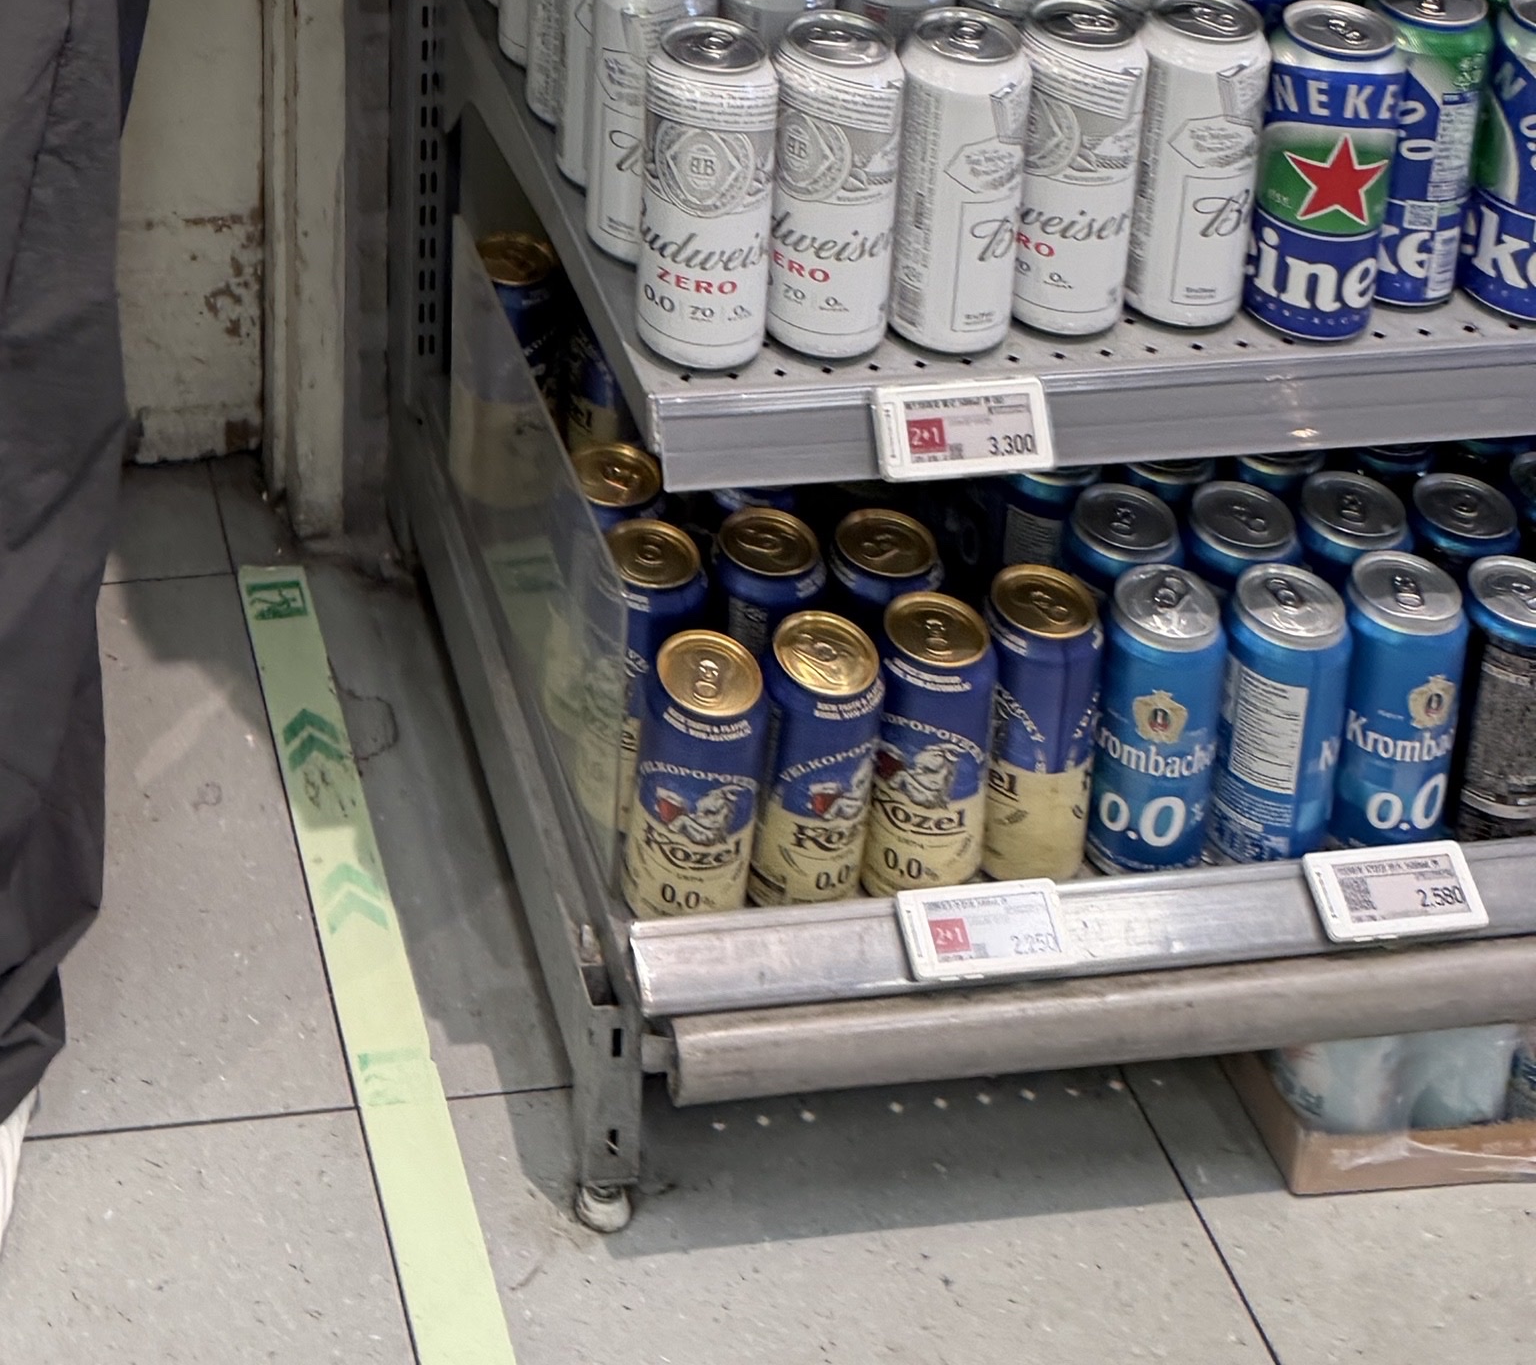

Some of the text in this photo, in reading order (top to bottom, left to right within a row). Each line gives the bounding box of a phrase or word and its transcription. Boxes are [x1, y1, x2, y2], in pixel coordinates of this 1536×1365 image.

[657, 266, 738, 295] ZERO
[644, 284, 675, 313] 0.0
[910, 427, 941, 445] 2+1
[644, 822, 742, 870] Kozel
